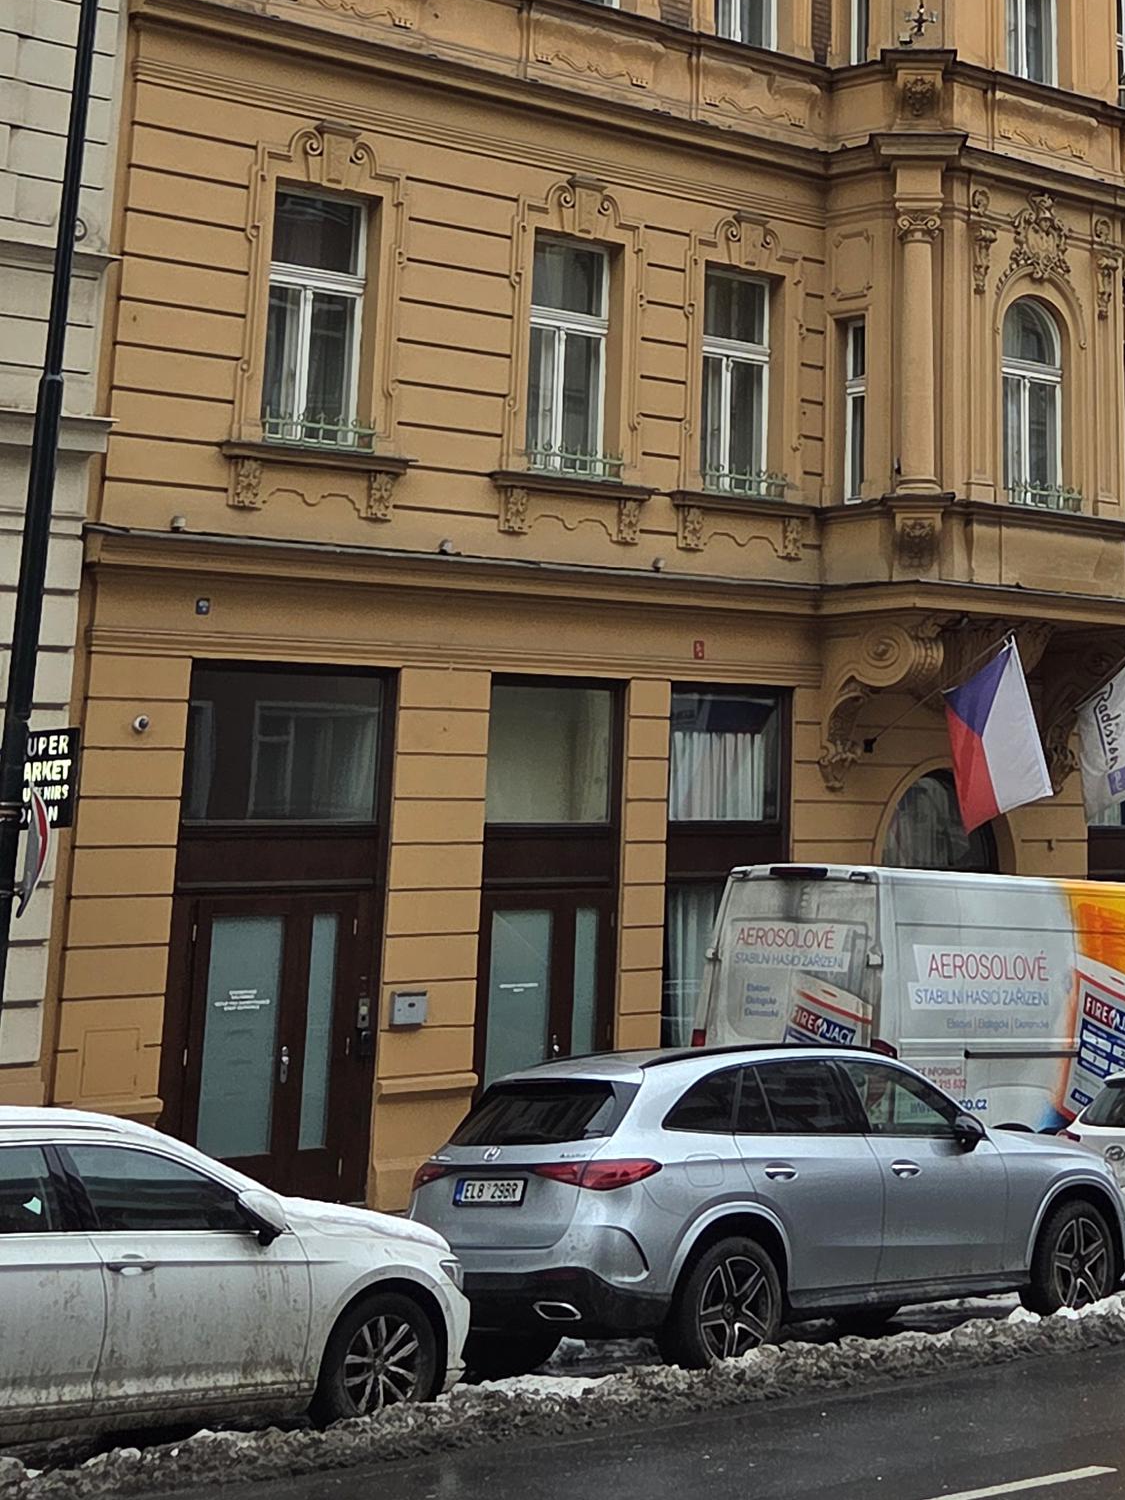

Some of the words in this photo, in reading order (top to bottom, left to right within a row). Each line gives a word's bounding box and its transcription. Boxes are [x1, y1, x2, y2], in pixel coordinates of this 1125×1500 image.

[1092, 682, 1121, 770] Radisson
[27, 735, 69, 757] UPER
[23, 759, 72, 782] ARKET
[736, 925, 835, 950] AEROSOLOVÉ
[928, 950, 1049, 981] AEROSOLOVÉ
